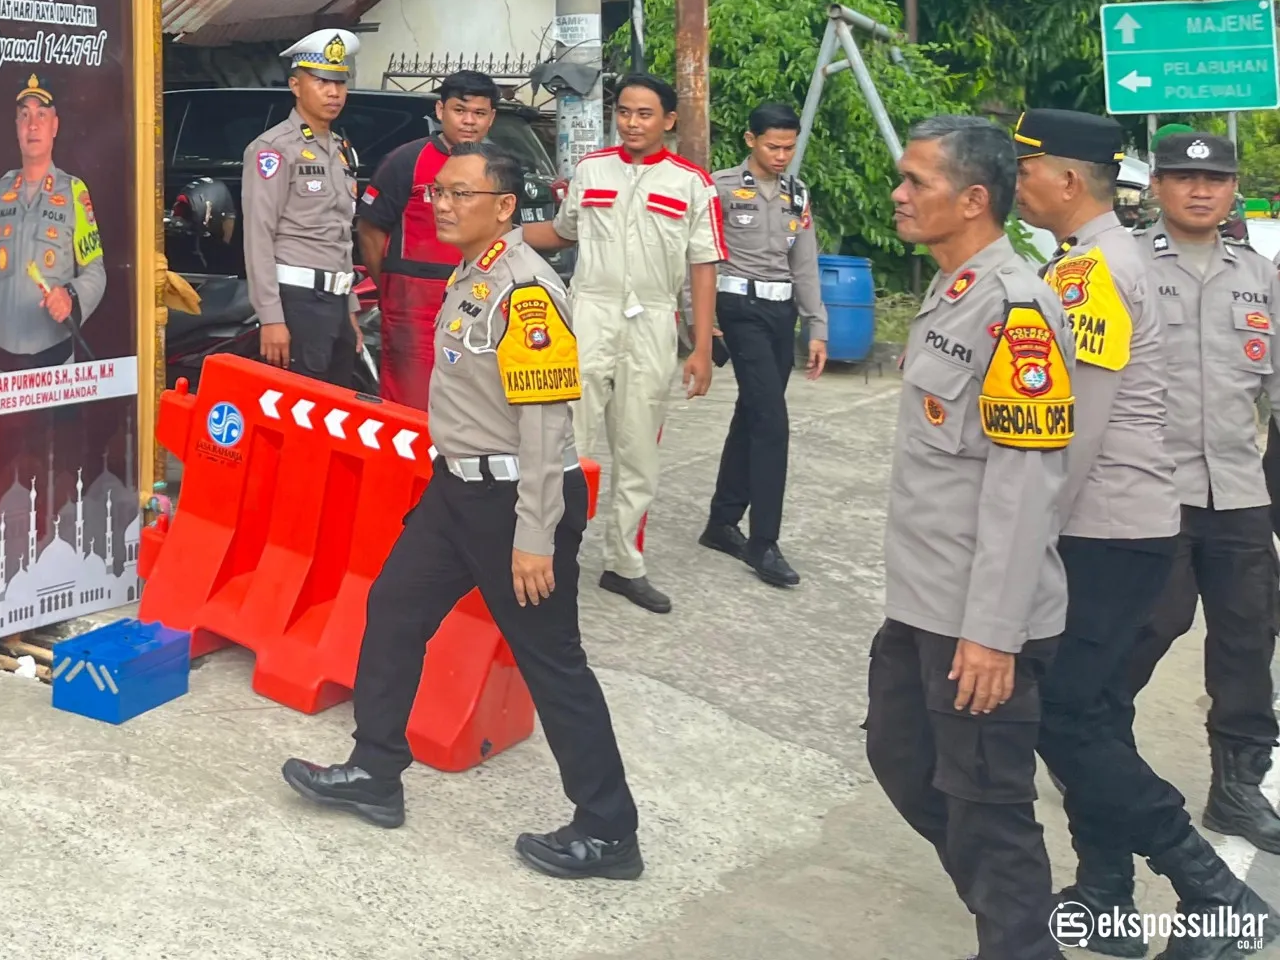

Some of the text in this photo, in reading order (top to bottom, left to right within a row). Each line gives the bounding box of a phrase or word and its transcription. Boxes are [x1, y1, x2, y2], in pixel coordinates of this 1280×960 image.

[35, 1, 55, 22] RAYA
[56, 3, 76, 24] IDUL
[76, 6, 97, 27] FITRI
[1186, 13, 1264, 34] MAJENE
[1163, 58, 1268, 76] PELABUHAN
[1165, 83, 1251, 100] POLEWALI
[42, 209, 66, 223] POLRI
[516, 300, 545, 311] POLDA
[1079, 314, 1106, 337] PAM
[925, 330, 973, 363] POLRI
[1075, 331, 1104, 356] ALI
[11, 371, 52, 391] PURWOKO
[99, 362, 114, 379] M.H
[20, 390, 61, 407] POLEWALI
[63, 385, 98, 401] MANDAR
[1046, 406, 1066, 435] OPS
